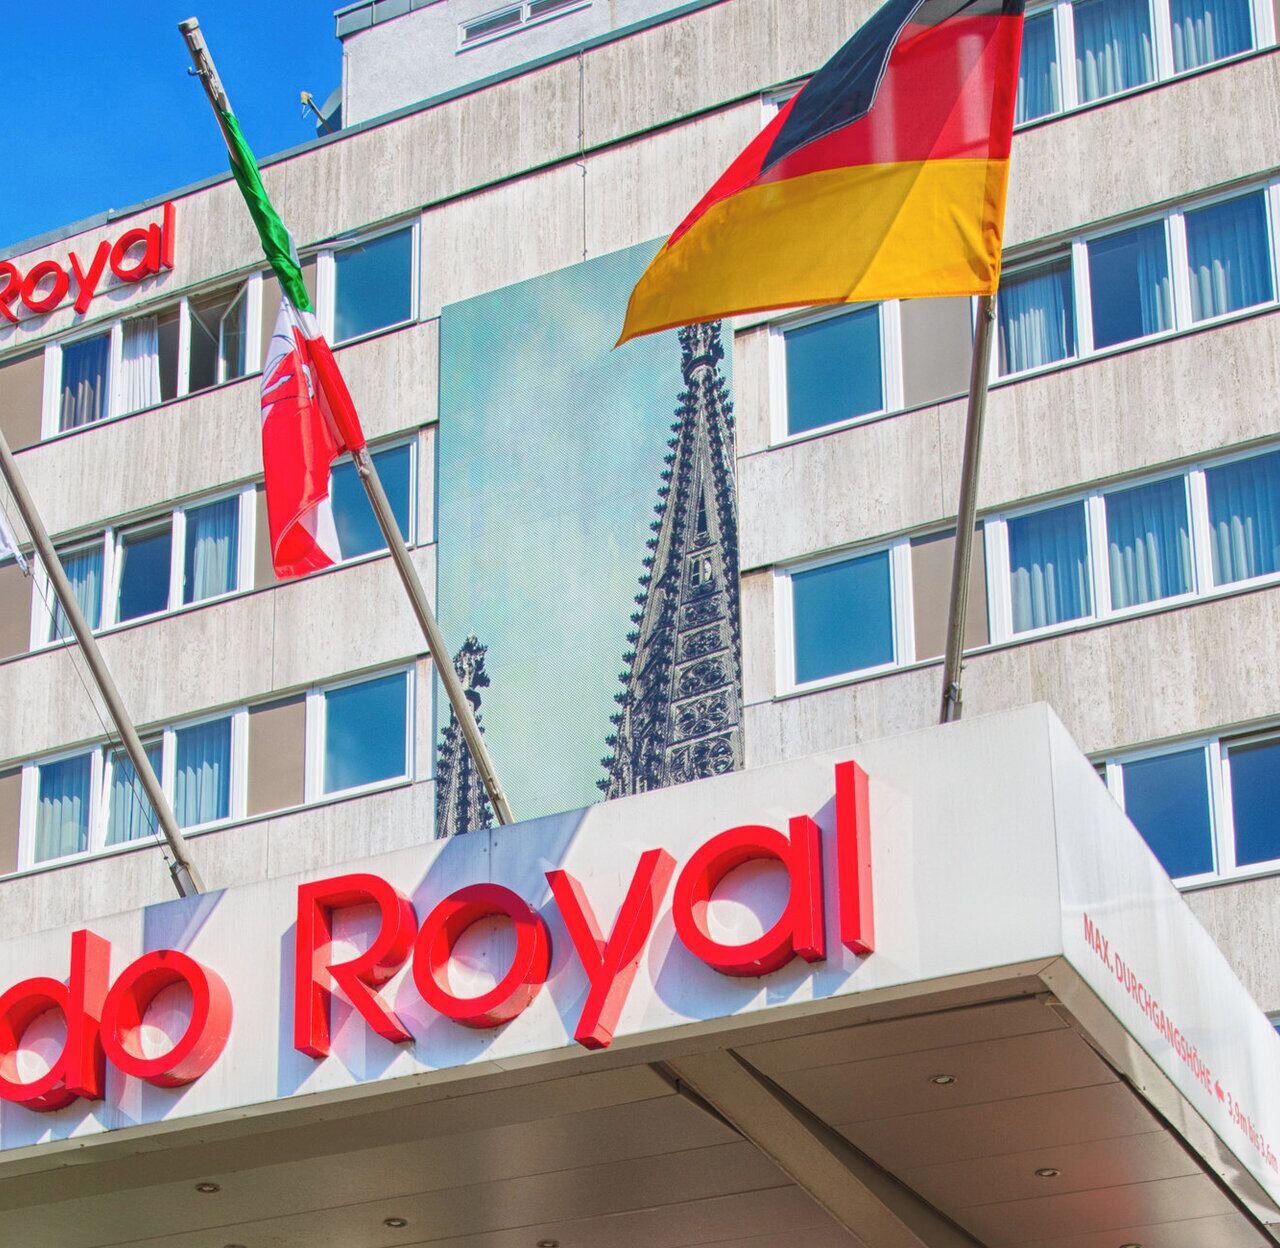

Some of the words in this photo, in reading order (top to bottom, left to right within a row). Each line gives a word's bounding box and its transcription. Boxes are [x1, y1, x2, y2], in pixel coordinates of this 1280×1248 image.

[294, 760, 875, 1050] Royal
[1083, 912, 1114, 973] MAX.
[1115, 951, 1212, 1096] DURCHGANGSHÖHE
